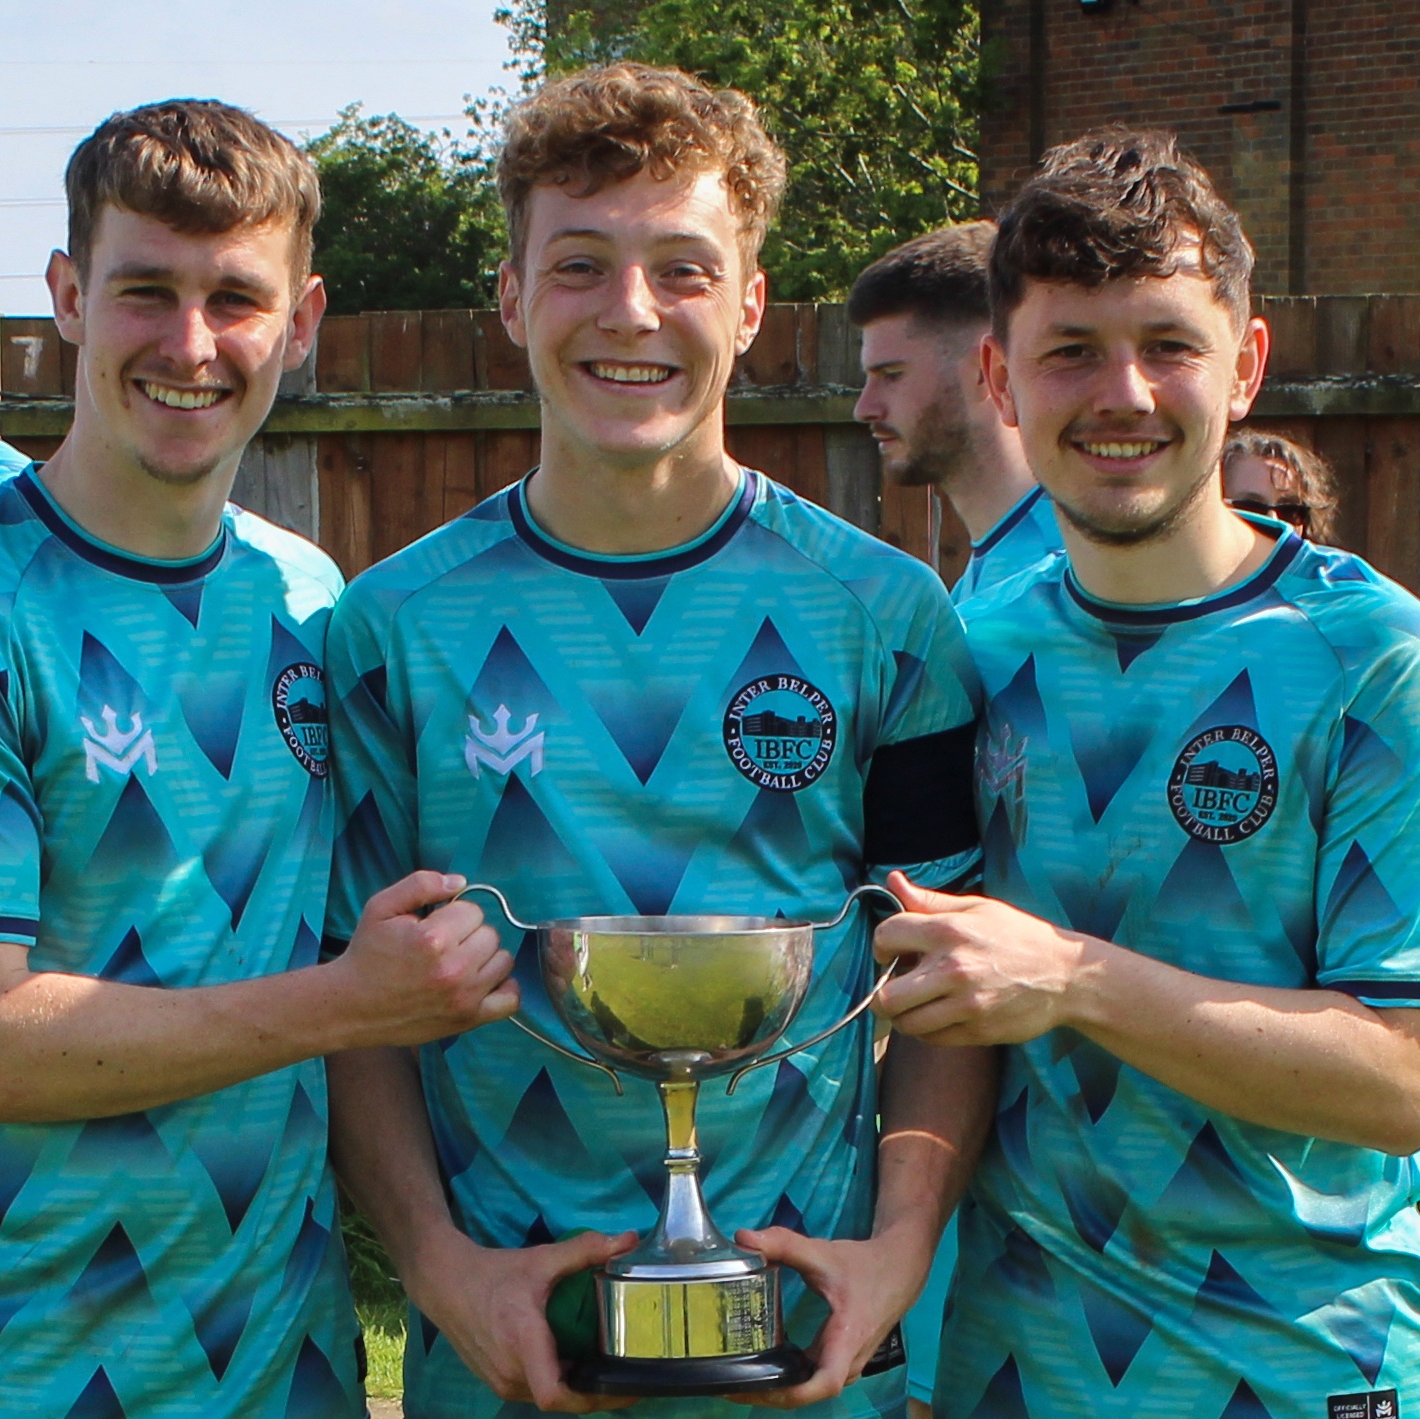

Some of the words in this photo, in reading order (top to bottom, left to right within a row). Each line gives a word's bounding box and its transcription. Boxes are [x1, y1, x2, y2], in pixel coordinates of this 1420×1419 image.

[10, 335, 44, 380] 7
[276, 668, 298, 709] INTER
[729, 680, 771, 721] INTER
[777, 677, 833, 724] BELPER
[728, 737, 801, 789] FOOTBALL
[804, 739, 833, 779] CLUB
[754, 740, 812, 760] IBFC
[1180, 729, 1224, 765] INTER
[1231, 728, 1275, 779] BELPER
[1170, 784, 1235, 840] FOOTBALL
[1239, 795, 1273, 833] CLUB
[1192, 788, 1250, 813] IBFC
